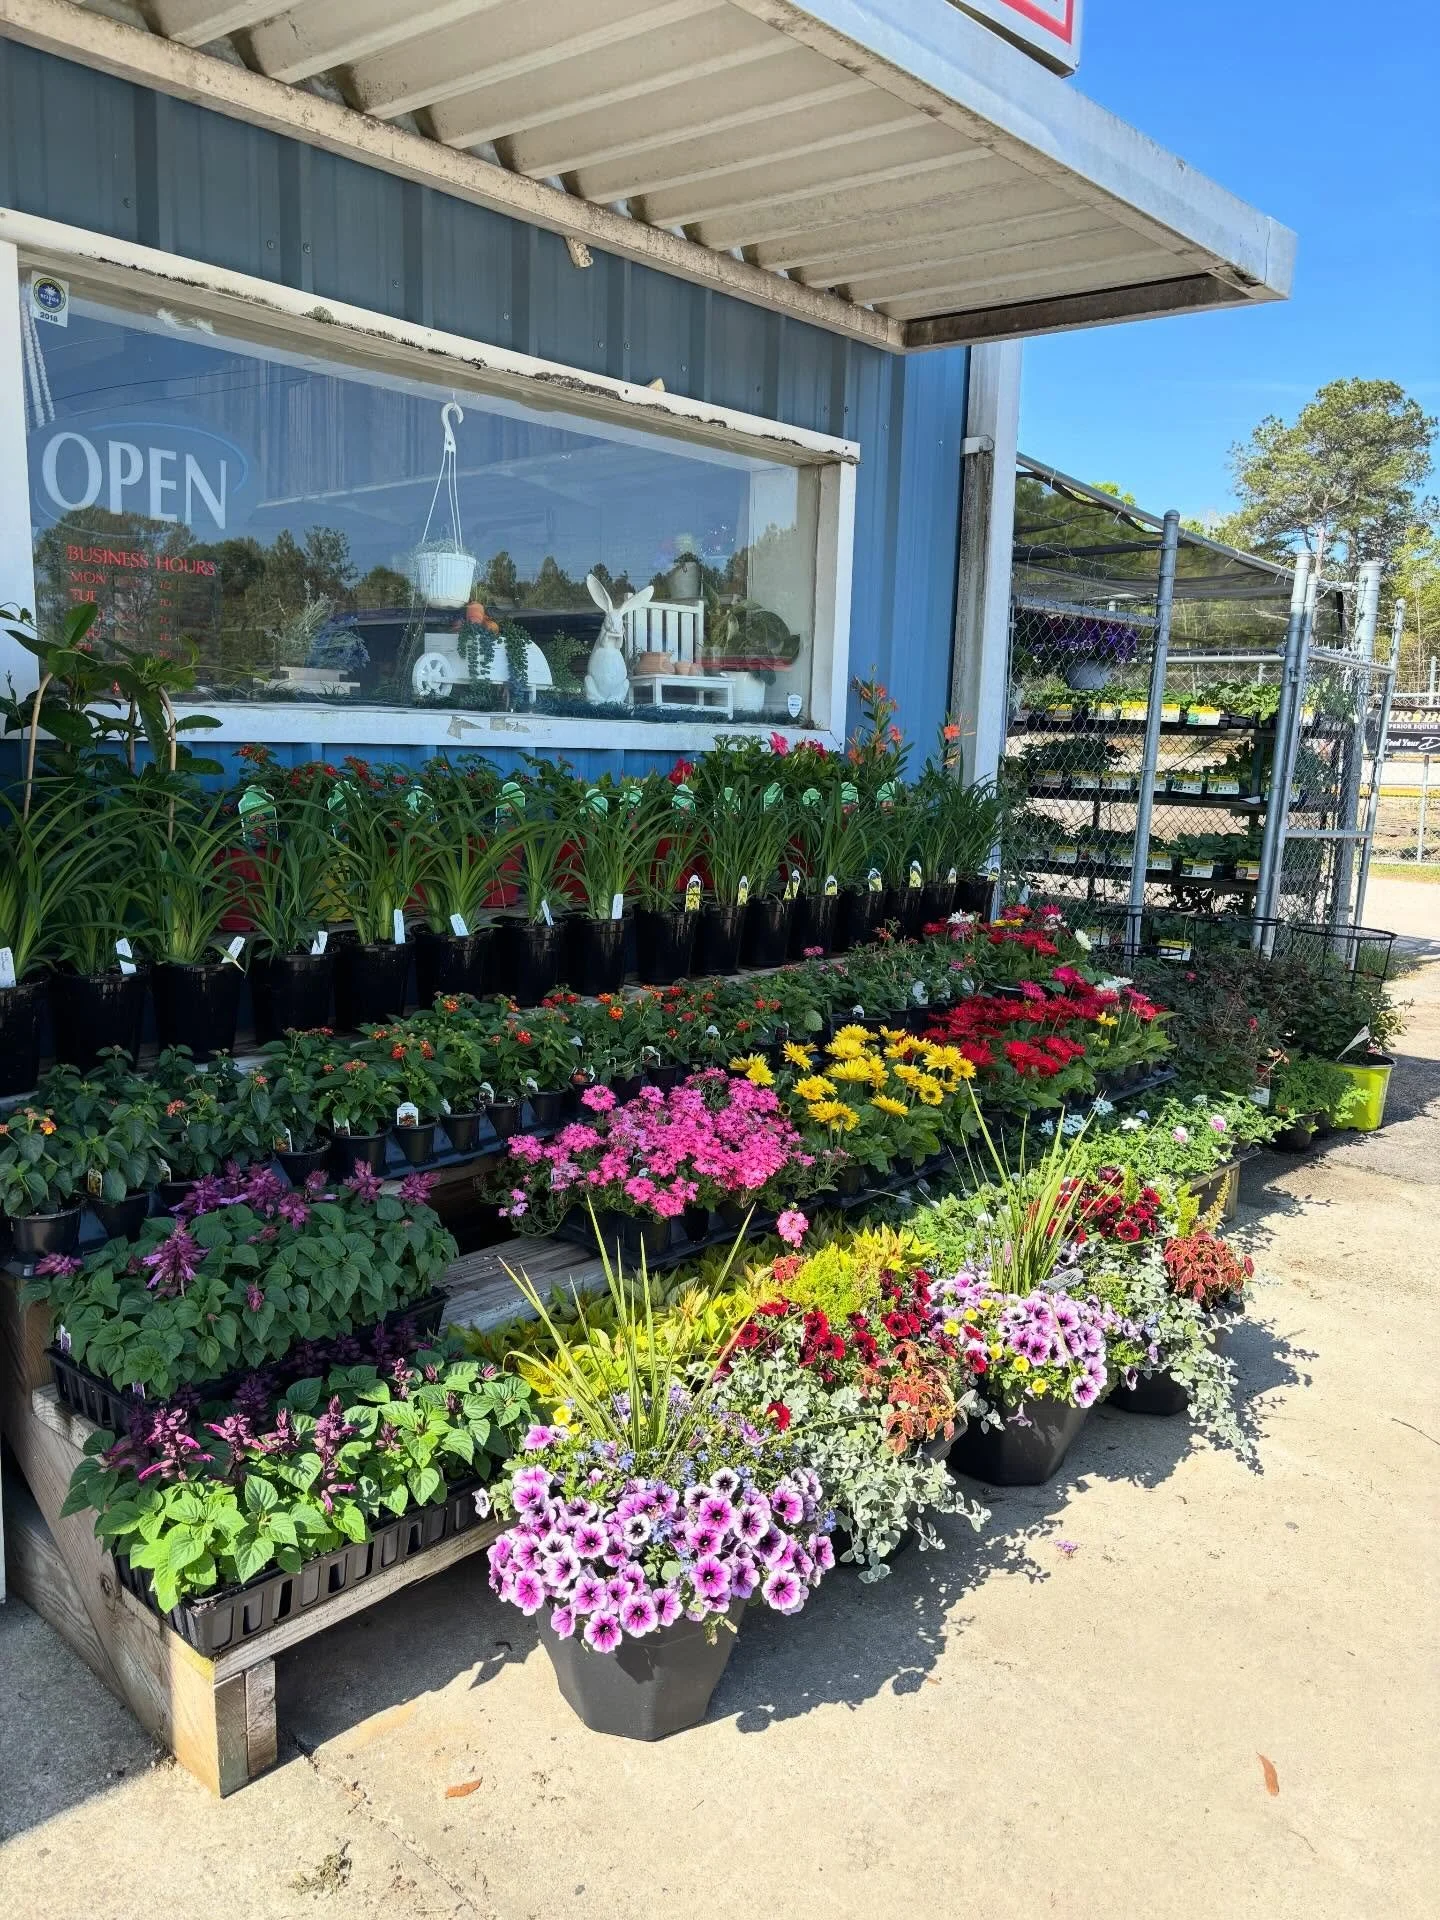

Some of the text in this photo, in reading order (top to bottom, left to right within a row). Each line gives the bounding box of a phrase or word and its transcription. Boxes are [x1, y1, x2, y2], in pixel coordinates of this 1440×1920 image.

[40, 312, 58, 323] 2018
[42, 432, 227, 530] OPEN
[66, 544, 216, 577] BUSINESS HOURS
[70, 571, 108, 585] MON
